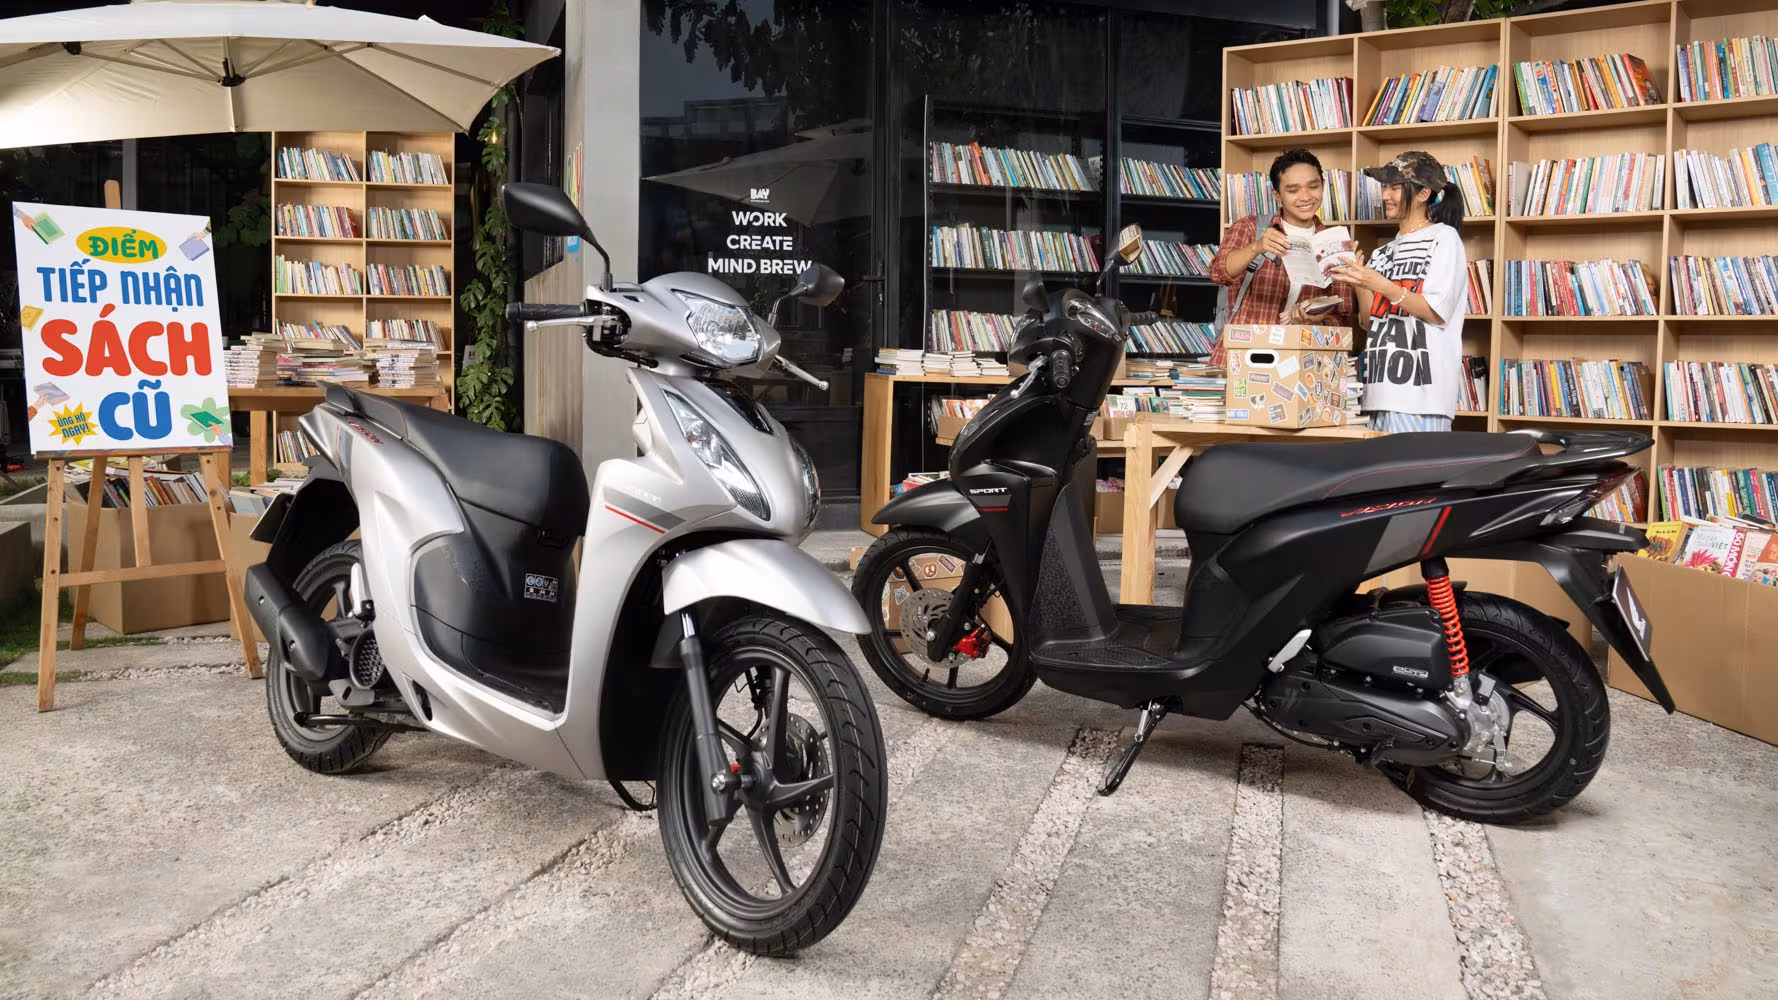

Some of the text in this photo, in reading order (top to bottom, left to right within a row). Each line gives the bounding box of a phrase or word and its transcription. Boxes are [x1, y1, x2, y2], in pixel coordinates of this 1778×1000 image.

[750, 188, 770, 200] BAY
[731, 211, 788, 227] WORK
[88, 229, 159, 259] ĐIỂM
[726, 234, 793, 250] CREATE
[707, 257, 812, 275] MIND BREW
[36, 258, 204, 312] TIẾP NHẬN
[40, 303, 212, 377] SÁCH
[98, 379, 173, 441] CŨ
